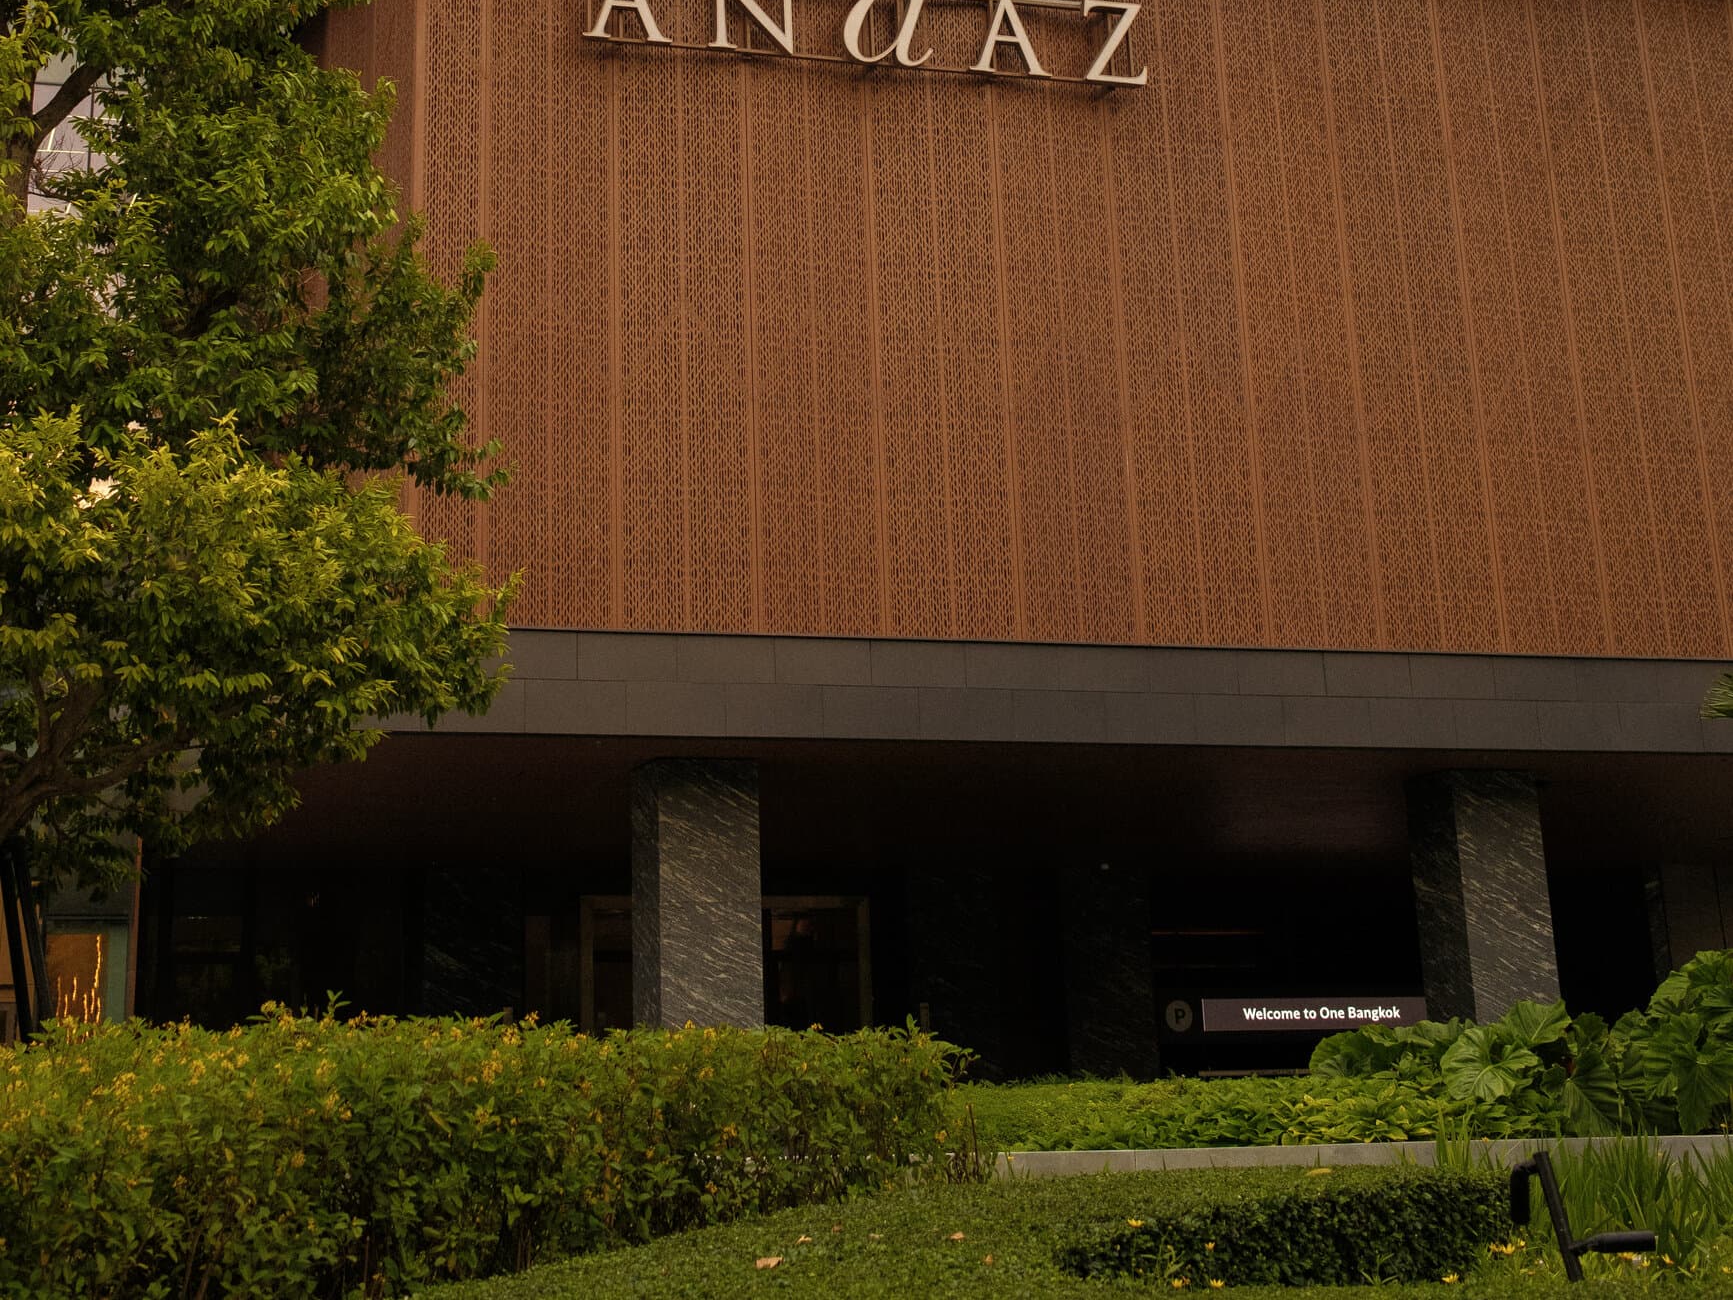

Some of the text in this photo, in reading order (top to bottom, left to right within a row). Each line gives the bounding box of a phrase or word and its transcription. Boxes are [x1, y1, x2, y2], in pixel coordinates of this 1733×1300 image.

[1174, 1007, 1186, 1025] P
[1243, 1005, 1401, 1021] Welcome to One Bangkok
